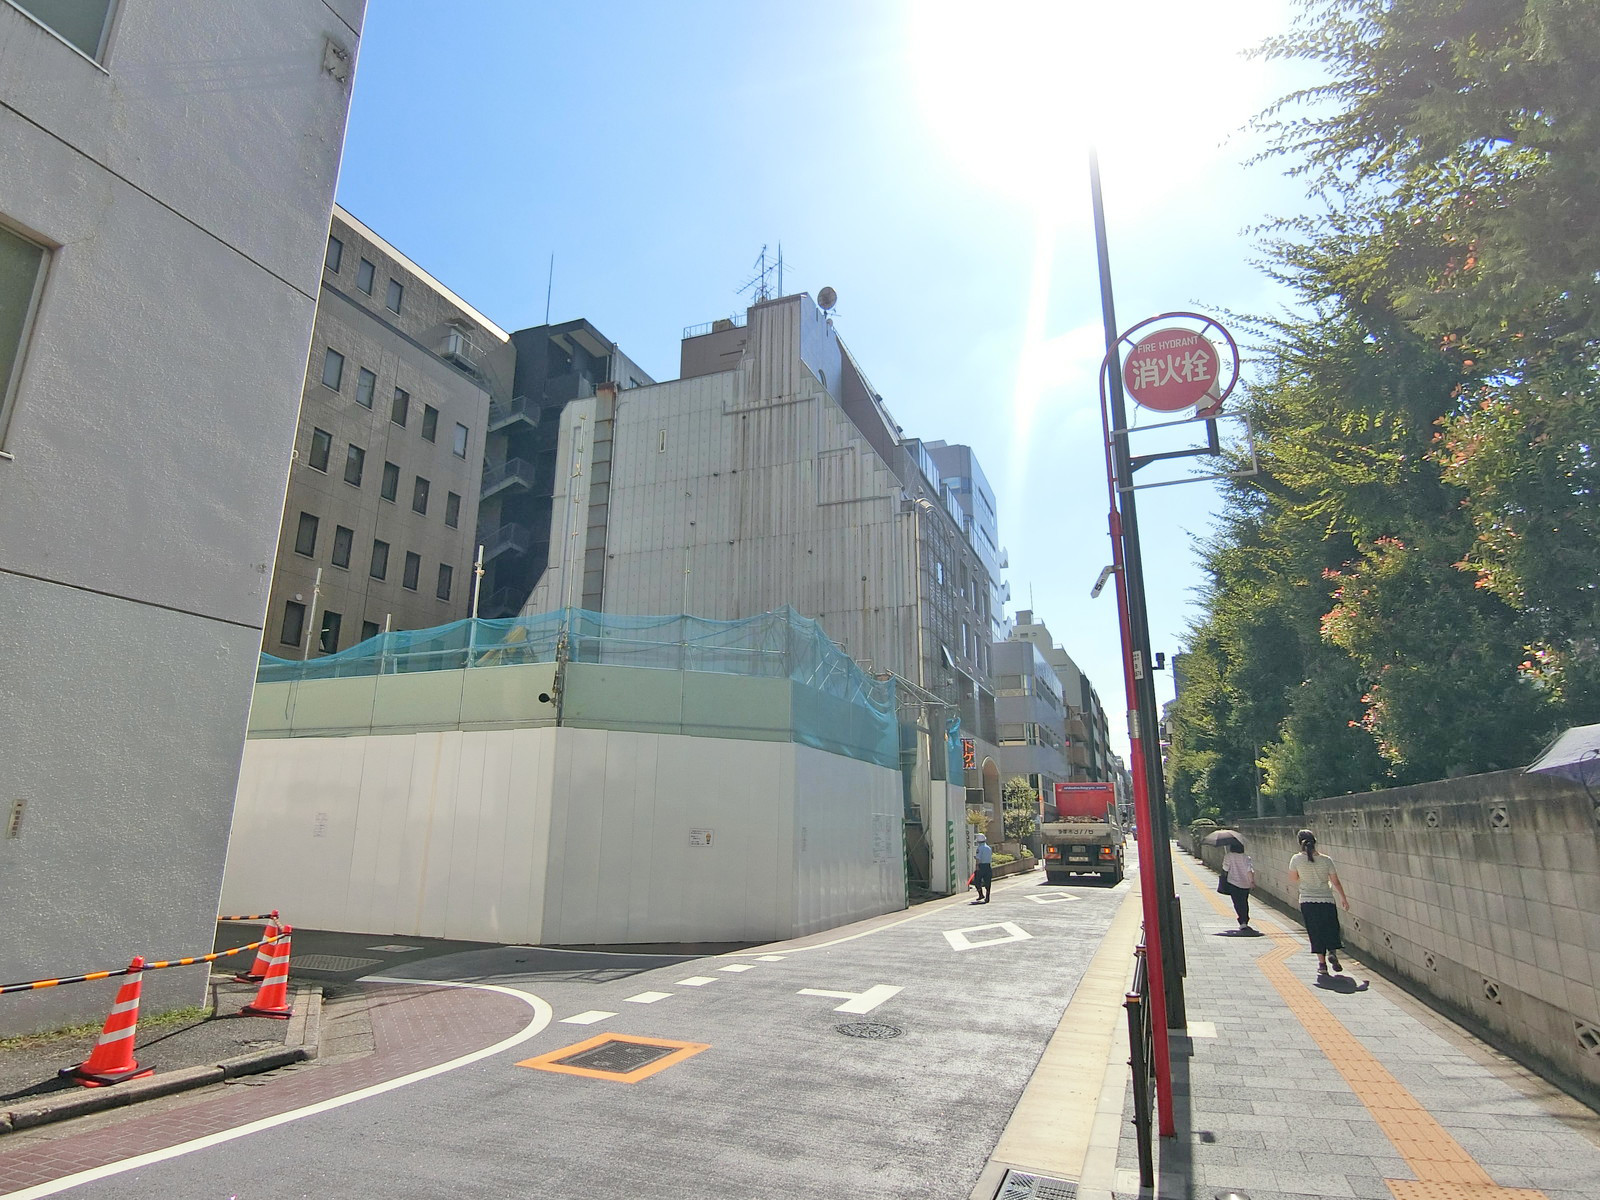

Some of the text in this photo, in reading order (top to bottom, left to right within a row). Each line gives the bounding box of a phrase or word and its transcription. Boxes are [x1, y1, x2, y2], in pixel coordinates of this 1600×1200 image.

[1137, 335, 1199, 354] FIRE HYDRANT
[1131, 349, 1211, 390] 消火栓
